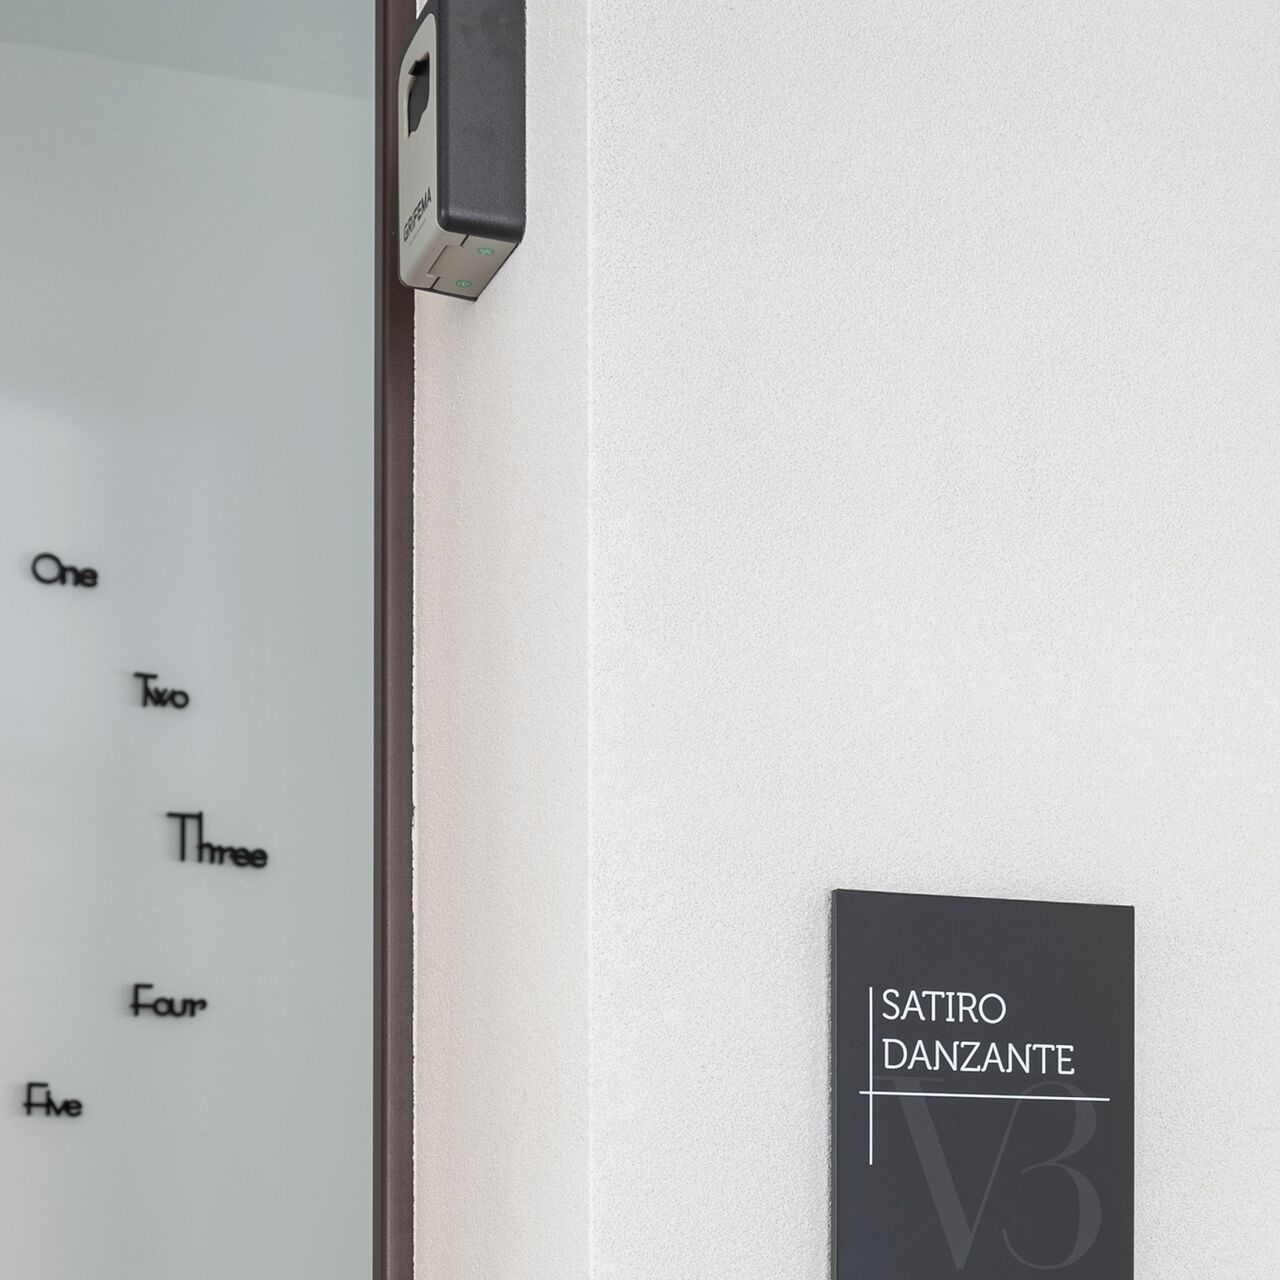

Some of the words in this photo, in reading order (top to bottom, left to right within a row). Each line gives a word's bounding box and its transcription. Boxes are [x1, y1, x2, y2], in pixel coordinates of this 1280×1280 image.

[403, 187, 432, 242] GRIFEMA
[31, 553, 99, 588] One
[133, 672, 190, 710] Two
[166, 811, 269, 869] Three
[129, 983, 208, 1018] Four
[882, 988, 1007, 1024] SATIRO
[882, 1038, 1075, 1075] DANZANTE
[23, 1082, 83, 1118] Five
[872, 1075, 1102, 1270] V3
